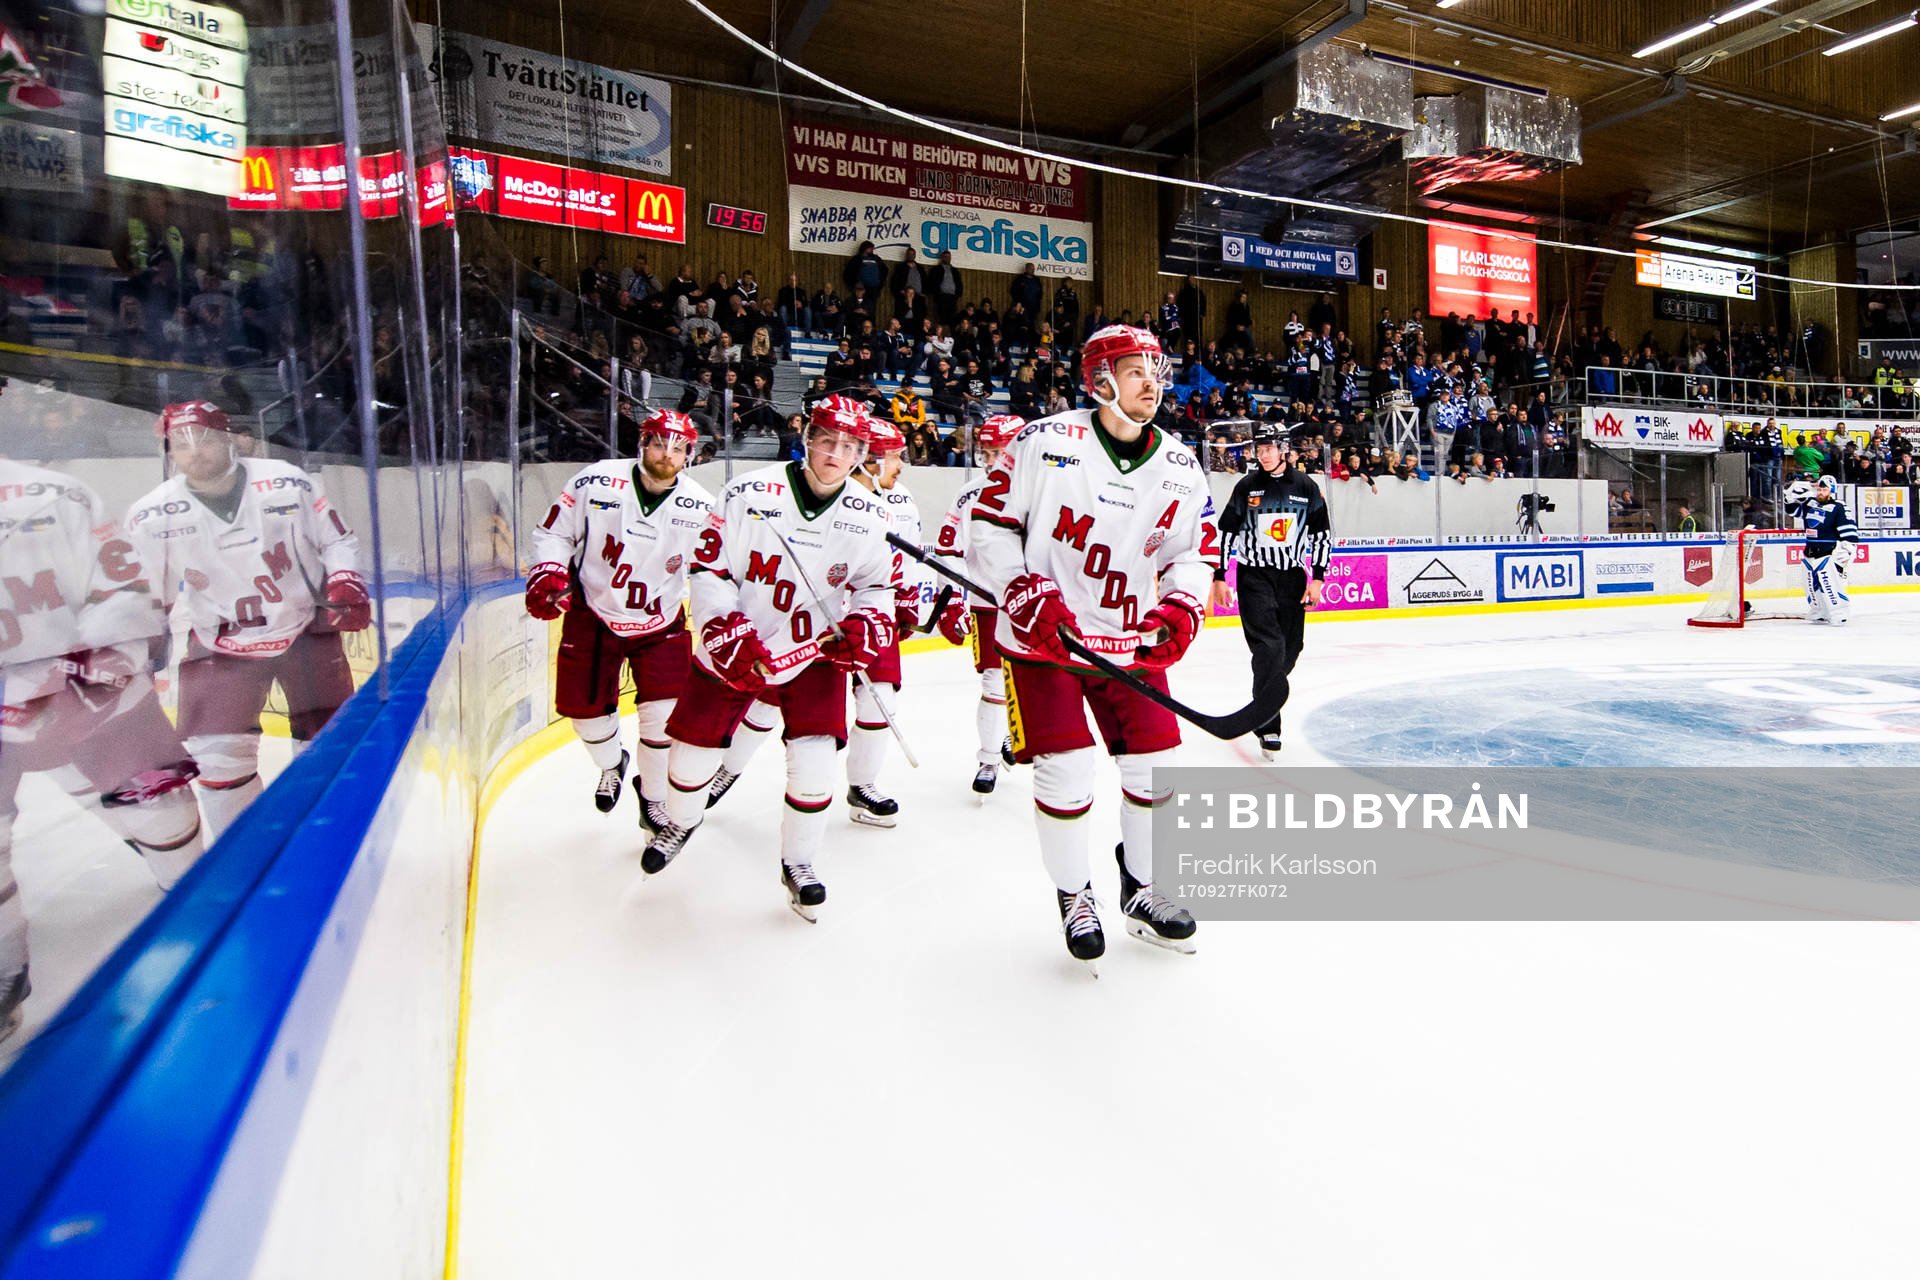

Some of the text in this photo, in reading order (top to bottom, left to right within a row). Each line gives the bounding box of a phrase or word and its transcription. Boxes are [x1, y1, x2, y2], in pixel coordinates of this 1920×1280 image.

[482, 50, 650, 112] TvättStället
[114, 108, 237, 149] grafiska
[793, 126, 1072, 186] VI HAR ALLT NI BEHÖVER INOM VVS
[793, 153, 830, 174] VVS
[836, 159, 907, 185] BUTIKEN
[909, 187, 1045, 214] BLOMSTERVÄGEN 27
[800, 204, 903, 224] SNABBA RYCK
[920, 206, 981, 222] KARLSKOGA
[799, 222, 911, 243] SNABBA TRYCK
[920, 218, 1088, 264] grafiska
[1036, 264, 1088, 277] AKTIEBOLAG
[1280, 260, 1317, 272] SUPPORT
[1460, 249, 1530, 272] KARLSKOGA
[1460, 264, 1531, 283] FOLKHÖGSKOLA
[1664, 264, 1695, 282] Arena
[1016, 420, 1089, 442] coreIT
[1594, 411, 1624, 437] MAX
[1653, 416, 1671, 428] BIK-
[1687, 417, 1714, 441] MAX
[1653, 430, 1680, 441] målet
[574, 475, 630, 490] coreIT
[977, 469, 1012, 513] 2
[1864, 493, 1894, 505] SWE
[1155, 499, 1181, 530] A
[1864, 506, 1895, 515] FLOOR
[833, 521, 870, 535] EITECH
[937, 525, 957, 548] 8
[1198, 521, 1221, 556] 2
[694, 528, 723, 564] 3
[1511, 563, 1573, 590] MABI
[1595, 563, 1655, 576] MOELVEN
[1411, 589, 1484, 600] AGGERUDS BYGG AB
[773, 647, 818, 668] ANTUM
